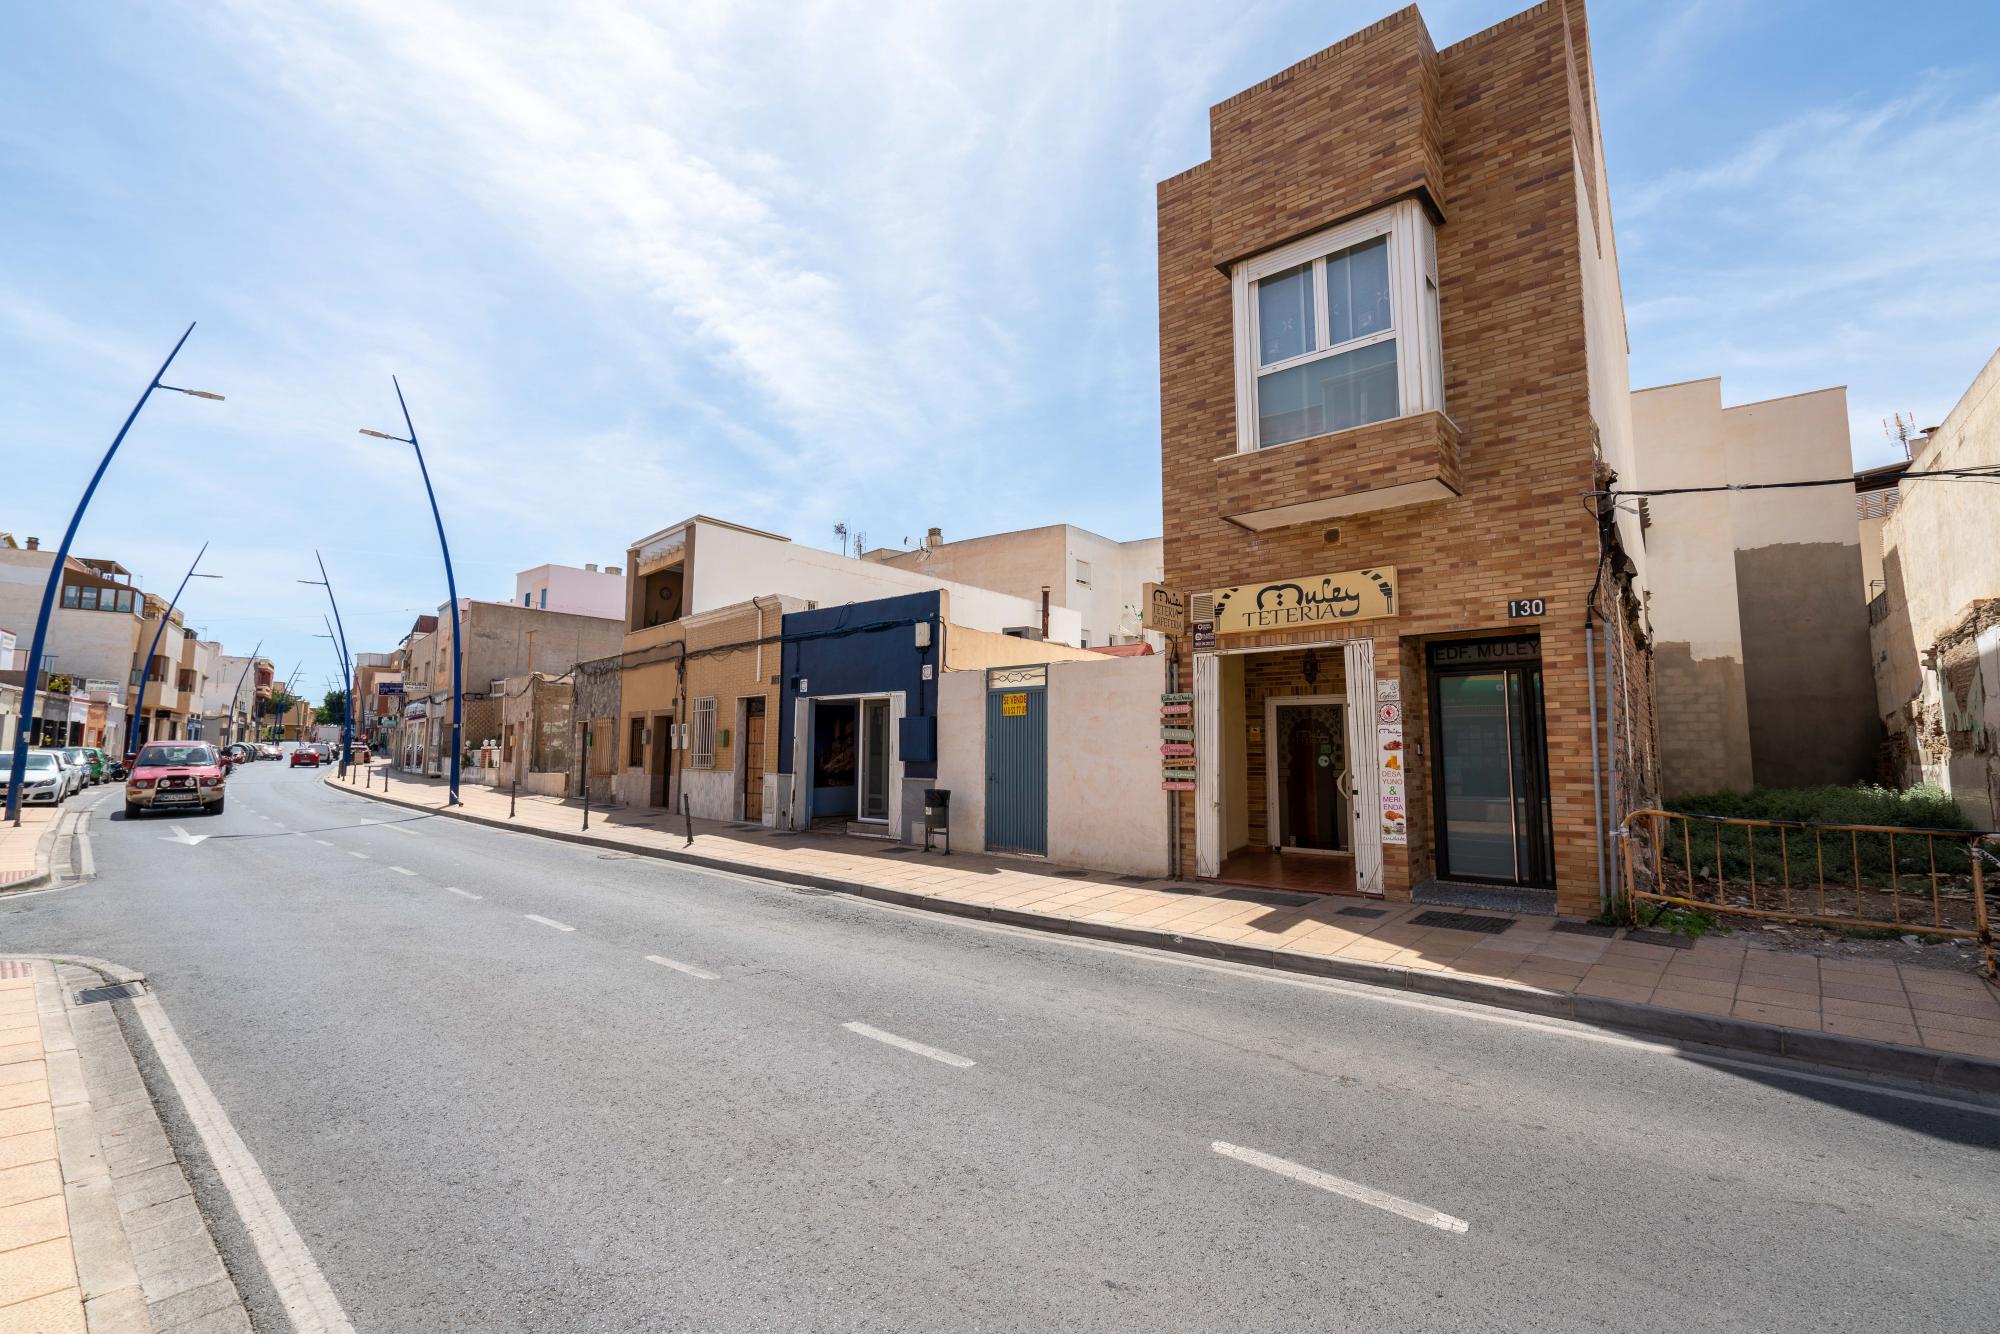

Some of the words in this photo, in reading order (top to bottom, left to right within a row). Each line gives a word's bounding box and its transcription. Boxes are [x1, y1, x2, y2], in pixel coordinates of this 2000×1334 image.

[1242, 604, 1339, 627] TETERIA
[1510, 599, 1543, 617] 130
[1435, 645, 1472, 660] EDF.
[1477, 641, 1538, 657] MULEY
[1010, 695, 1027, 704] VENDE
